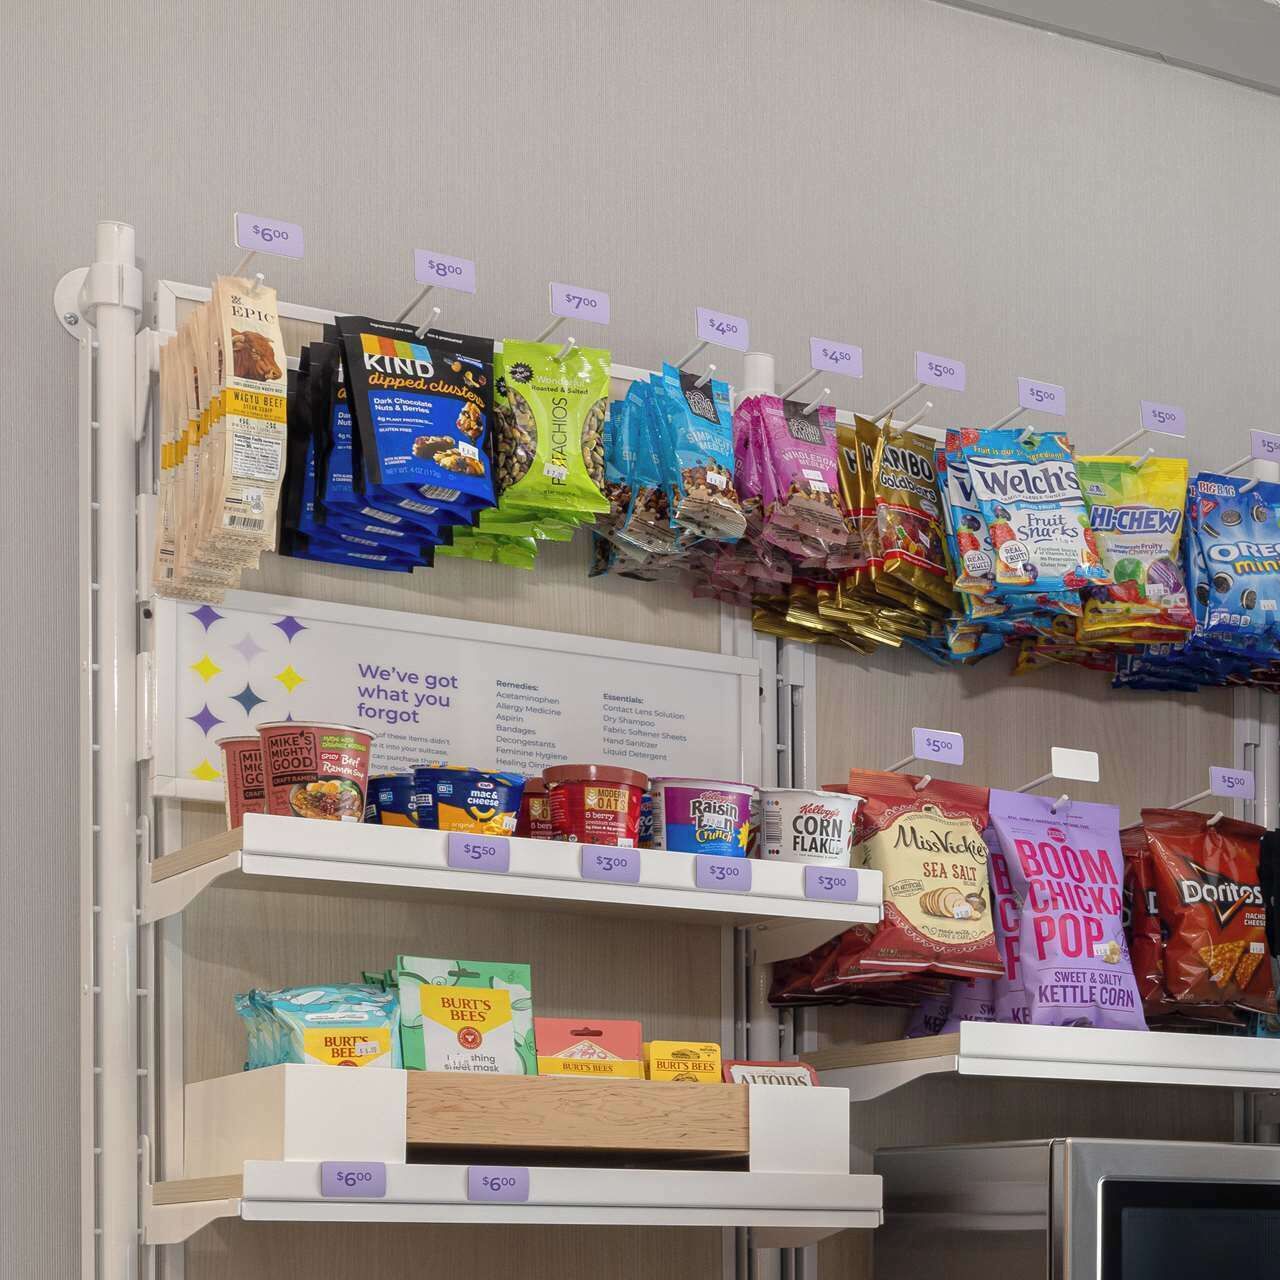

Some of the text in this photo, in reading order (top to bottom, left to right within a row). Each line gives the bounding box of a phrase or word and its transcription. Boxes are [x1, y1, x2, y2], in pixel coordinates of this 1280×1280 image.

[232, 305, 275, 324] EPIC
[364, 353, 434, 377] KIND
[369, 372, 485, 408] dipped clusters
[394, 398, 432, 408] Chocolate
[880, 471, 936, 502] Goldbears
[976, 467, 1079, 495] Welch's
[1198, 481, 1216, 494] BIG
[1027, 513, 1066, 526] Fruit
[359, 663, 459, 689] We've got
[496, 680, 539, 691] Remedies:
[358, 684, 450, 708] what you
[496, 691, 560, 705] Acetaminophen
[603, 694, 644, 704] Essentials:
[357, 702, 419, 724] forgot
[496, 703, 561, 716] Allergy Medicine
[603, 704, 685, 720] Contact Lens Solution
[496, 713, 524, 723] Aspirin
[603, 715, 655, 727] Dry Shampoo
[496, 725, 536, 735] Bandages
[603, 726, 687, 742] Fabric Softener Sheets
[270, 735, 312, 747] MIKE'S
[496, 736, 556, 749] Decongestants
[603, 737, 657, 748] Hand Sanitizer
[272, 747, 312, 759] MIGHTY
[496, 747, 568, 761] Feminine Hygiene
[603, 748, 667, 761] Liquid Detergent
[496, 758, 527, 768] Healing
[274, 776, 292, 785] CRAFT
[598, 789, 626, 798] MODERN
[598, 798, 626, 810] OATS
[692, 799, 738, 819] Raisin
[592, 812, 614, 820] berry
[793, 816, 842, 837] CORN
[696, 829, 735, 843] Crunch
[1014, 839, 1119, 885] BOOM
[923, 863, 977, 882] SEA SALT
[1028, 879, 1121, 916] CHICKA
[1182, 880, 1263, 904] Doritos
[1033, 913, 1104, 960] POP
[1055, 971, 1122, 986] SWEET & SALTY
[1038, 985, 1134, 1008] KETTLE CORN
[441, 997, 491, 1010] BURT'S
[450, 1010, 485, 1022] BEES
[325, 1036, 368, 1047] BURT'S
[473, 1064, 499, 1072] mask
[562, 1063, 613, 1072] BURT'S BEES
[657, 1061, 714, 1071] BURT'S BEES
